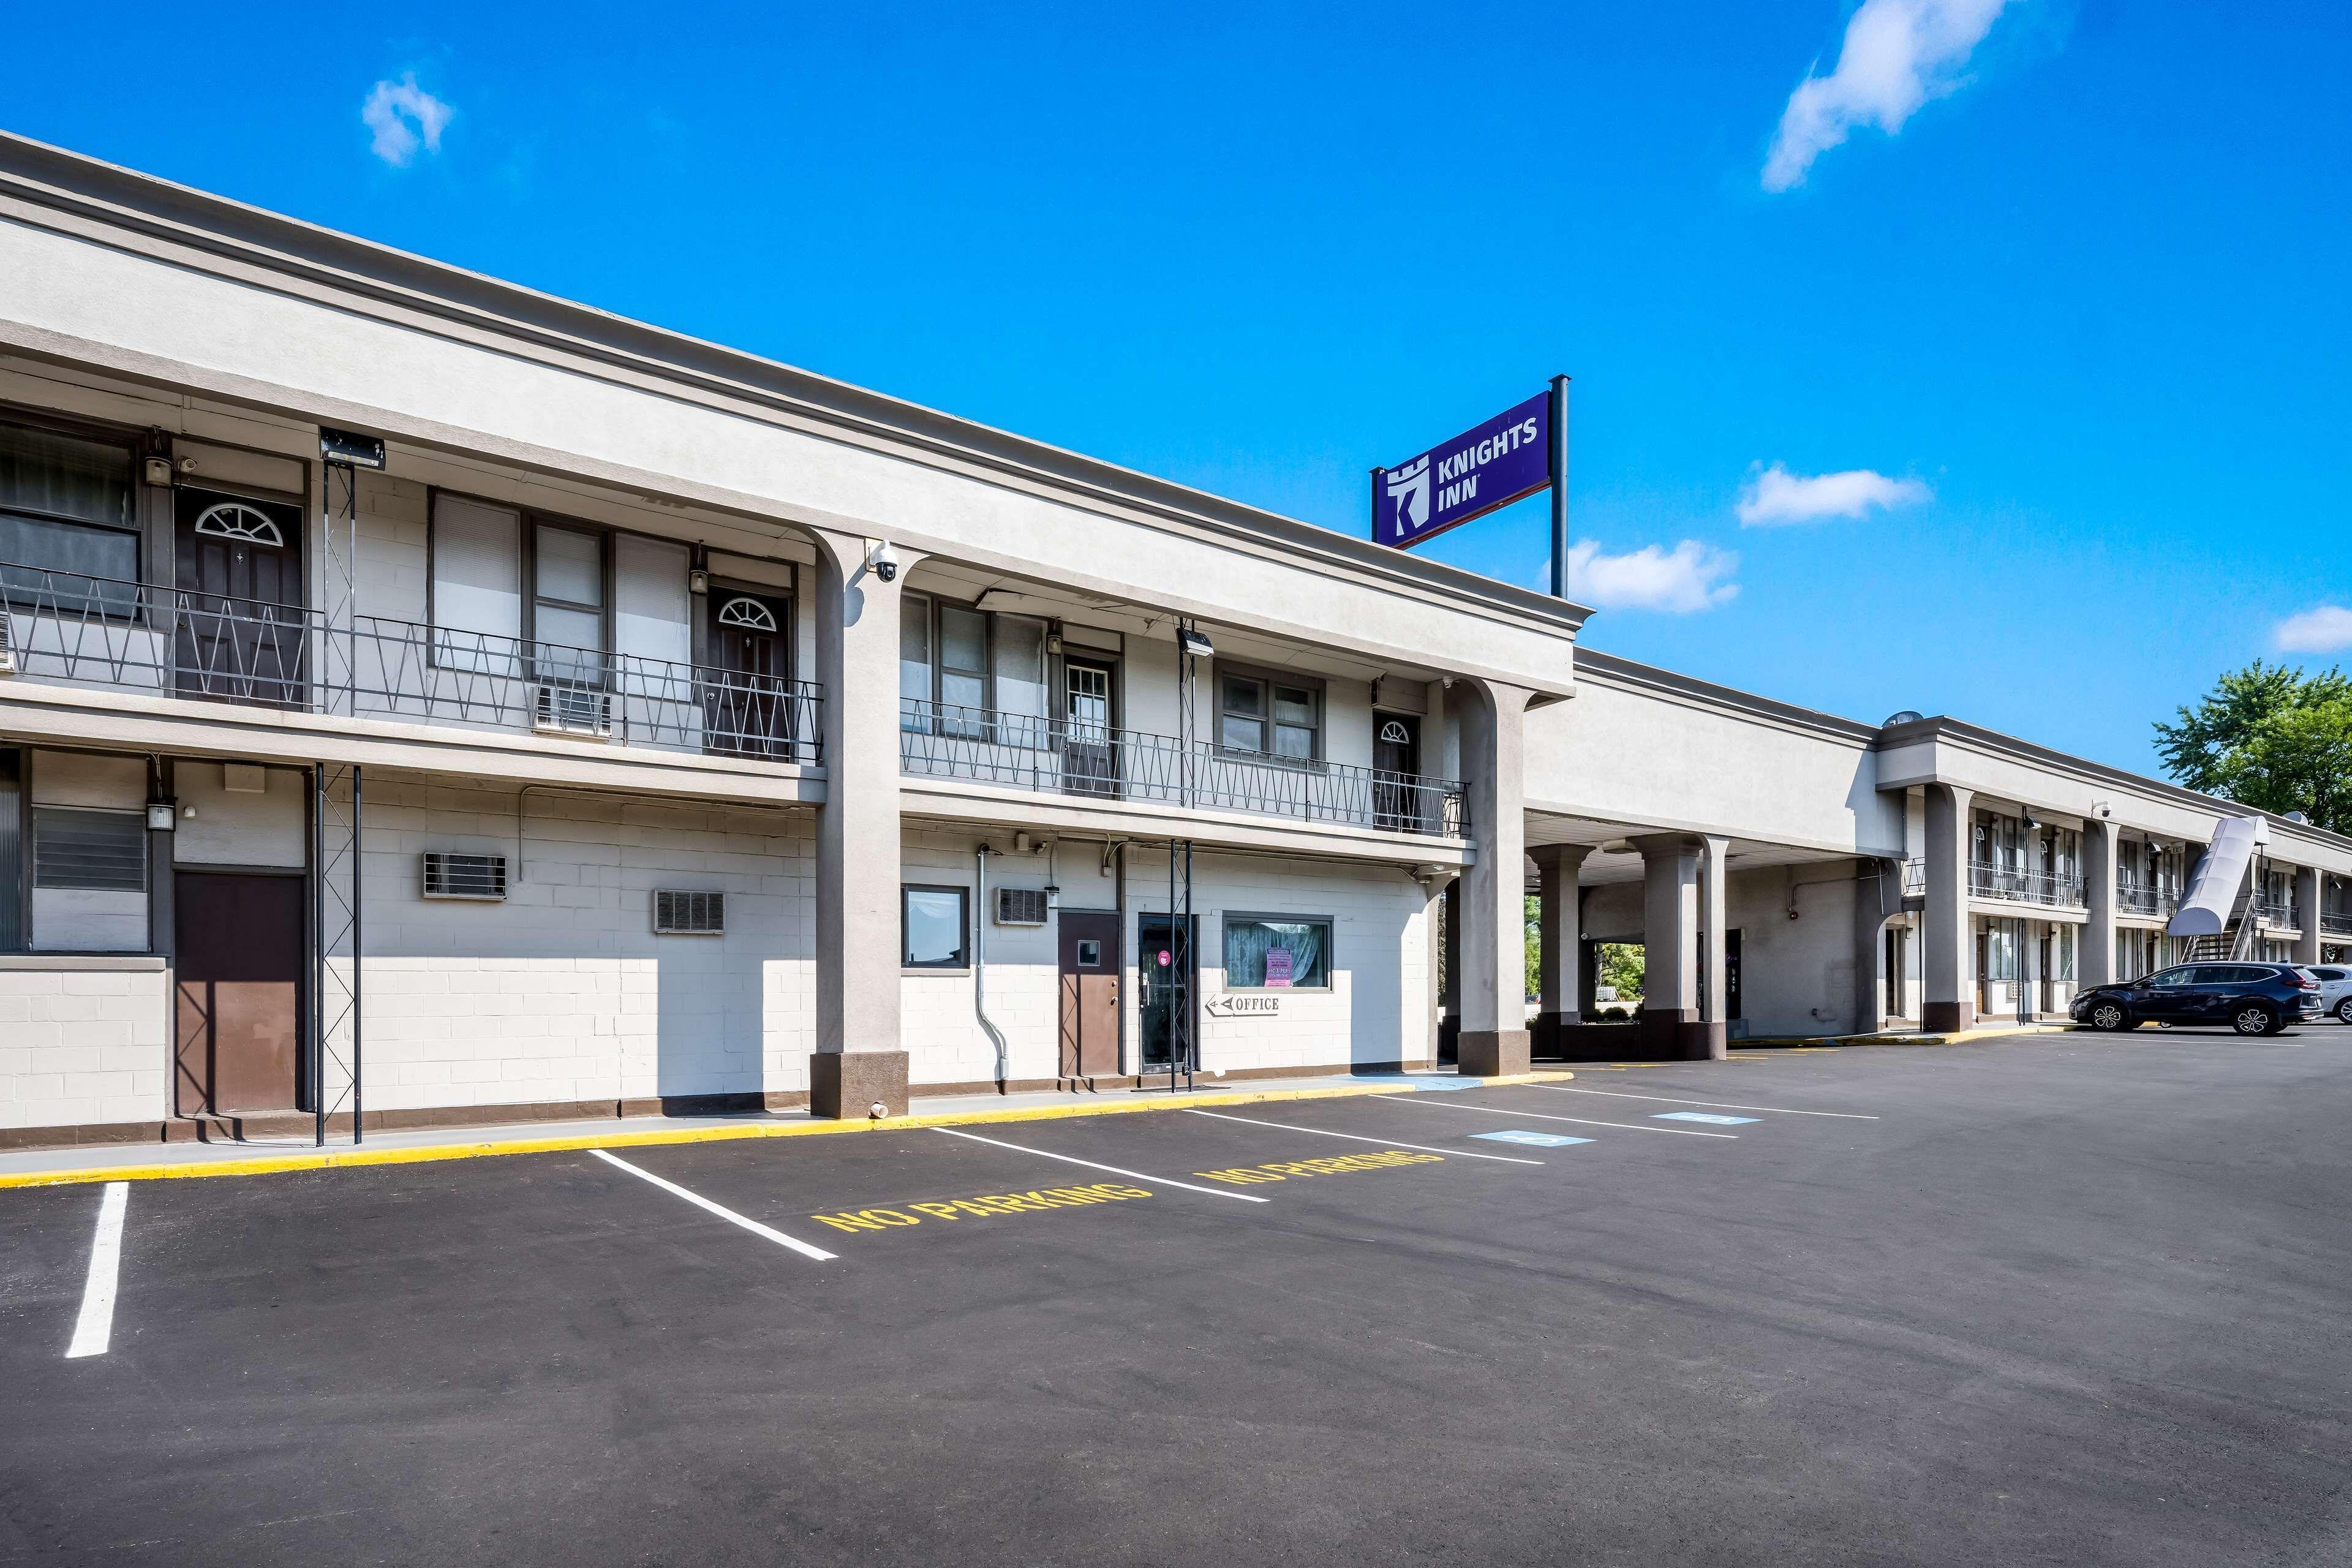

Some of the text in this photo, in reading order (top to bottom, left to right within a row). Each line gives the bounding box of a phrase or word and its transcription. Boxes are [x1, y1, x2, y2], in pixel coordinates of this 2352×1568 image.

[1439, 417, 1537, 484] KNIGHTS
[1438, 475, 1477, 512] INN
[1236, 998, 1279, 1011] OFFICE
[1192, 1150, 1446, 1185] NO PARKING
[810, 1183, 1153, 1233] NO PARKING
